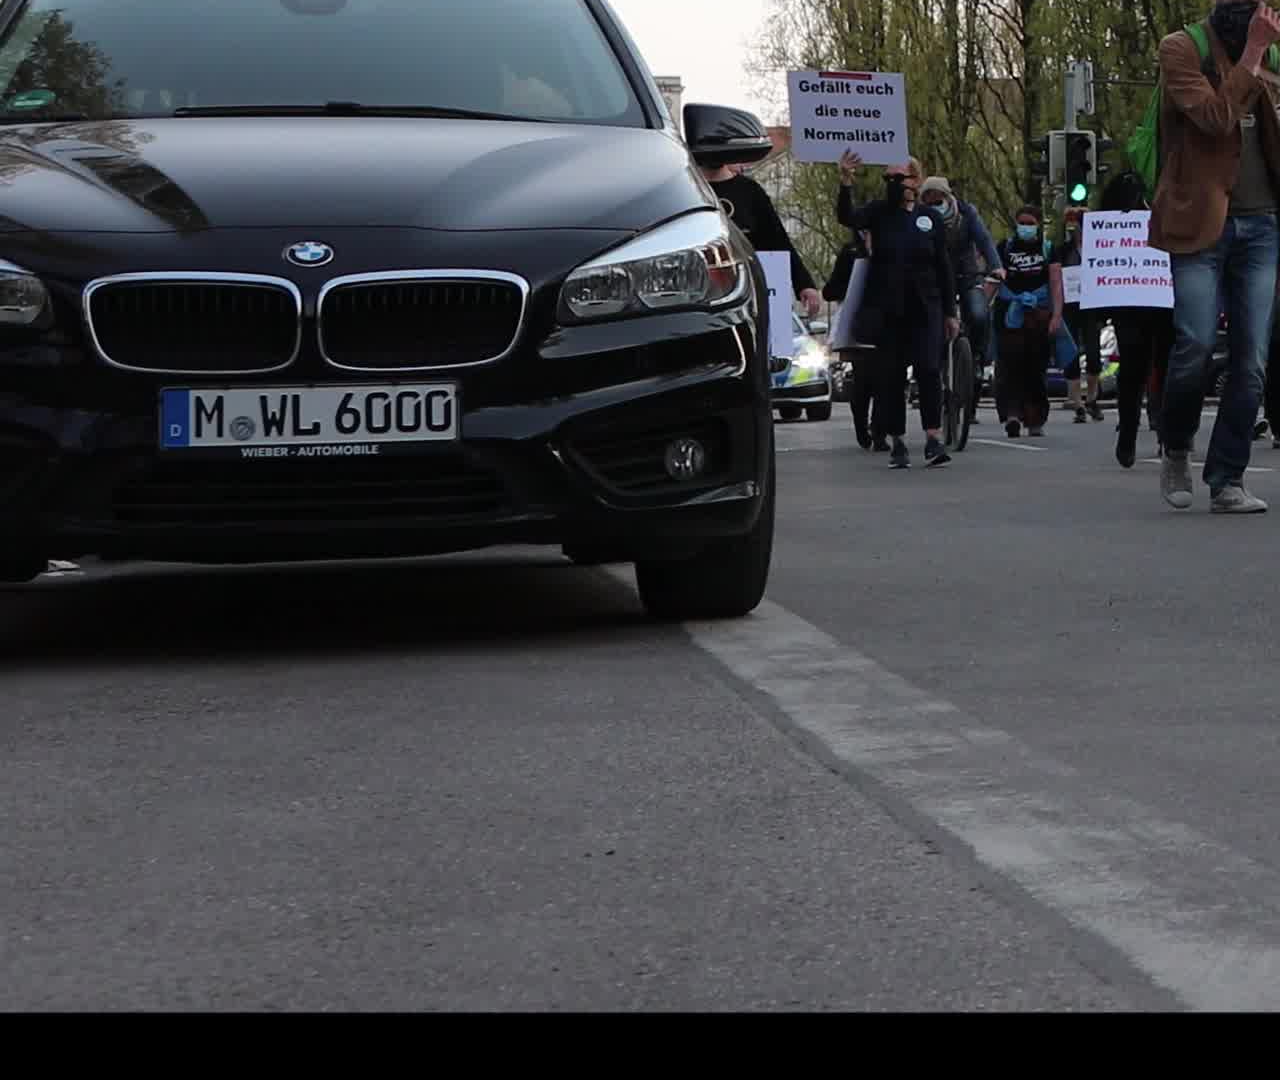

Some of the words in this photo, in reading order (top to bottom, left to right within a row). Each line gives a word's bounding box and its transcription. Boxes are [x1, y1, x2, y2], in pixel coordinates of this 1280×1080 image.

[798, 80, 852, 94] Gefällt
[855, 82, 895, 96] euch
[814, 104, 839, 117] die
[842, 106, 882, 119] neue
[803, 127, 896, 144] Normalität?
[1090, 220, 1143, 231] Warum
[1095, 238, 1118, 249] für
[1086, 257, 1138, 269] Tests),
[169, 423, 182, 438] D
[193, 394, 225, 439] M
[258, 393, 322, 437] WL
[334, 389, 454, 435] 6000
[241, 446, 289, 458] WIEBER
[297, 444, 380, 457] AUTOMOBILE
